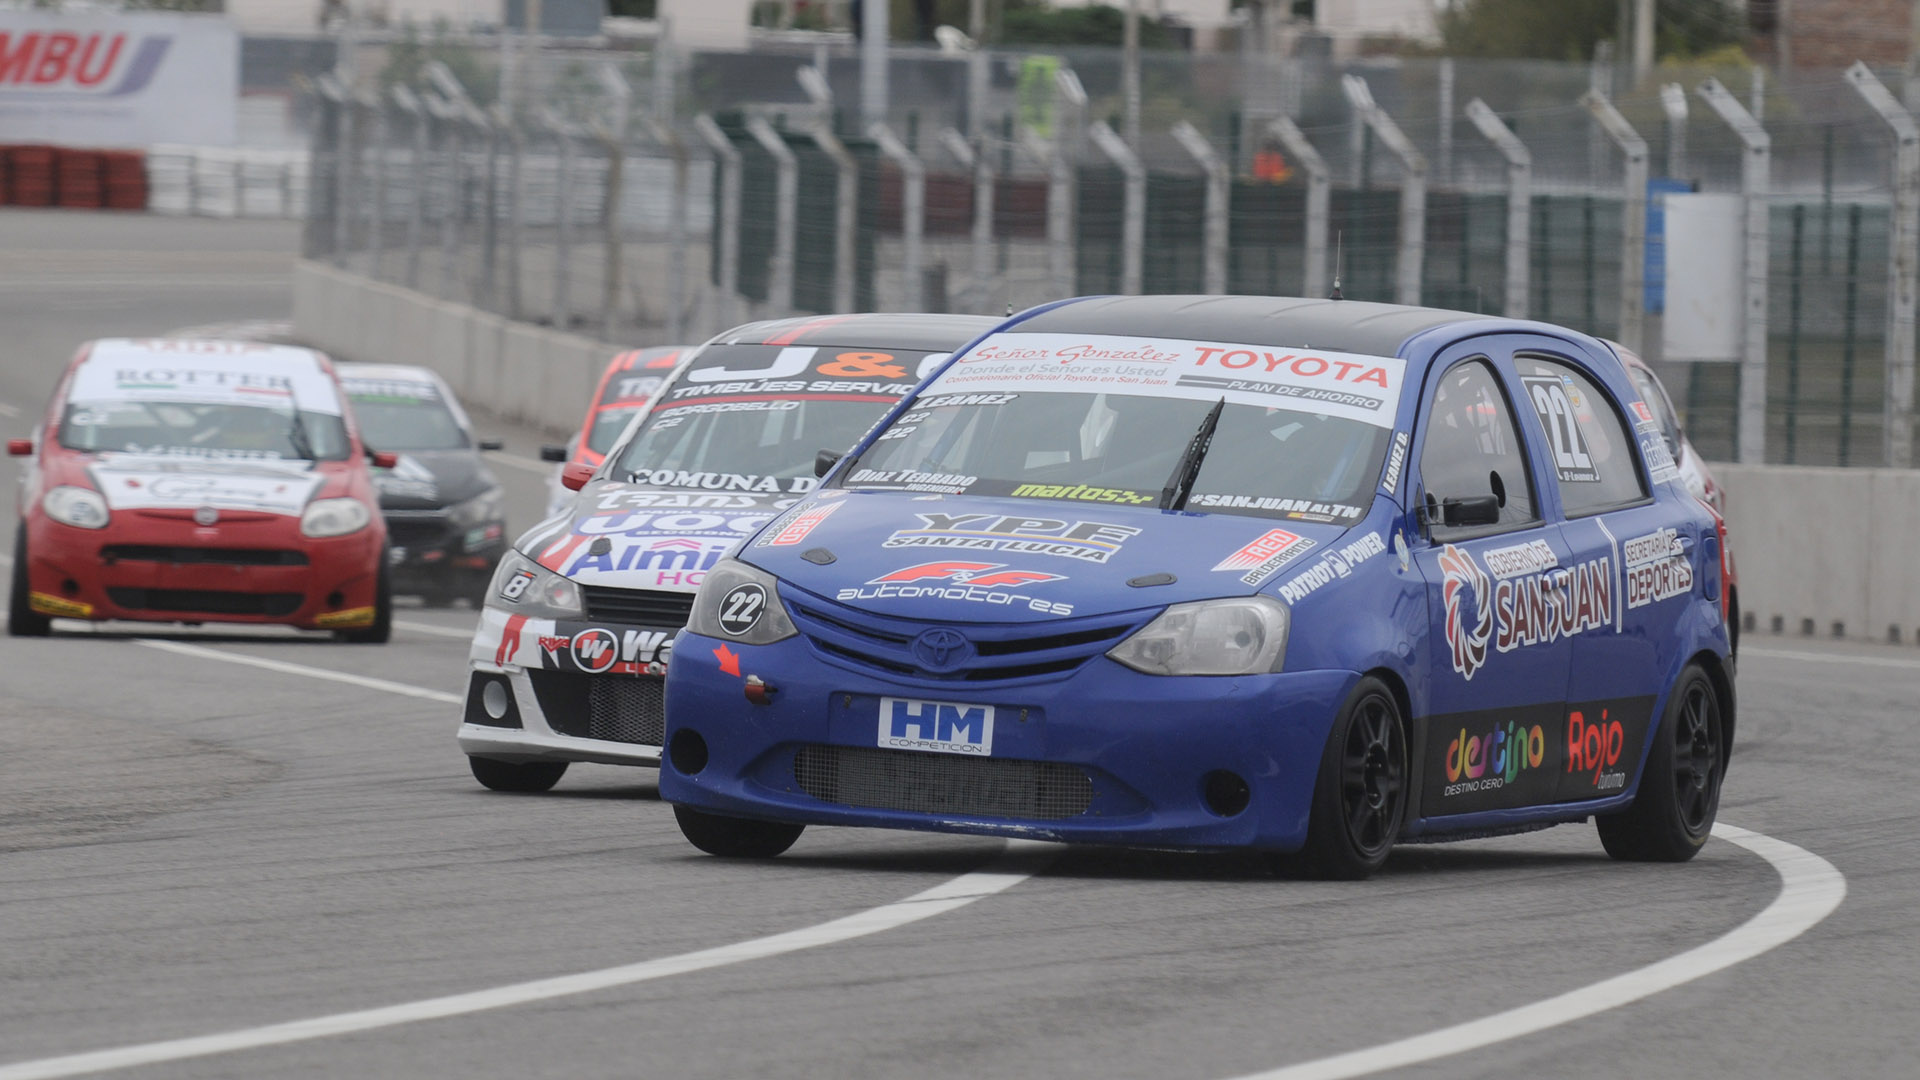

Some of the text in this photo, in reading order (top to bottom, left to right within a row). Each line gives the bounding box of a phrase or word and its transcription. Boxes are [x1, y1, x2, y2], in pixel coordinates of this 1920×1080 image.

[959, 362, 1169, 377] Donde el Señor es Usted
[1025, 373, 1062, 382] Oficial
[1063, 374, 1098, 382] Toyota
[1117, 376, 1140, 384] San
[1140, 377, 1169, 386] Juan
[1195, 346, 1389, 389] TOYOTA
[673, 377, 806, 399] TIMBÚES
[1227, 380, 1380, 409] PLAN DE AHORRO
[659, 401, 800, 419] BORGOBELLO
[911, 394, 1020, 410] LEANEZ
[650, 417, 685, 431] C2
[898, 411, 932, 425] C2
[1532, 384, 1593, 469] 22
[877, 426, 917, 441] 22
[628, 469, 781, 493] COMUNA
[920, 513, 1139, 543] YPF
[887, 537, 1109, 562] SANTA LUCIA
[1486, 544, 1556, 576] GOBIERNO DE
[1278, 531, 1387, 606] PATRIOT POWER
[1629, 560, 1692, 604] DEPORTES
[721, 592, 763, 623] 22
[837, 584, 1074, 616] automotores
[890, 700, 985, 745] HM
[889, 738, 983, 753] COMPETICION
[1445, 720, 1544, 784] destino
[1567, 708, 1624, 785] Rojo
[1444, 778, 1504, 797] DESTINO CERO
